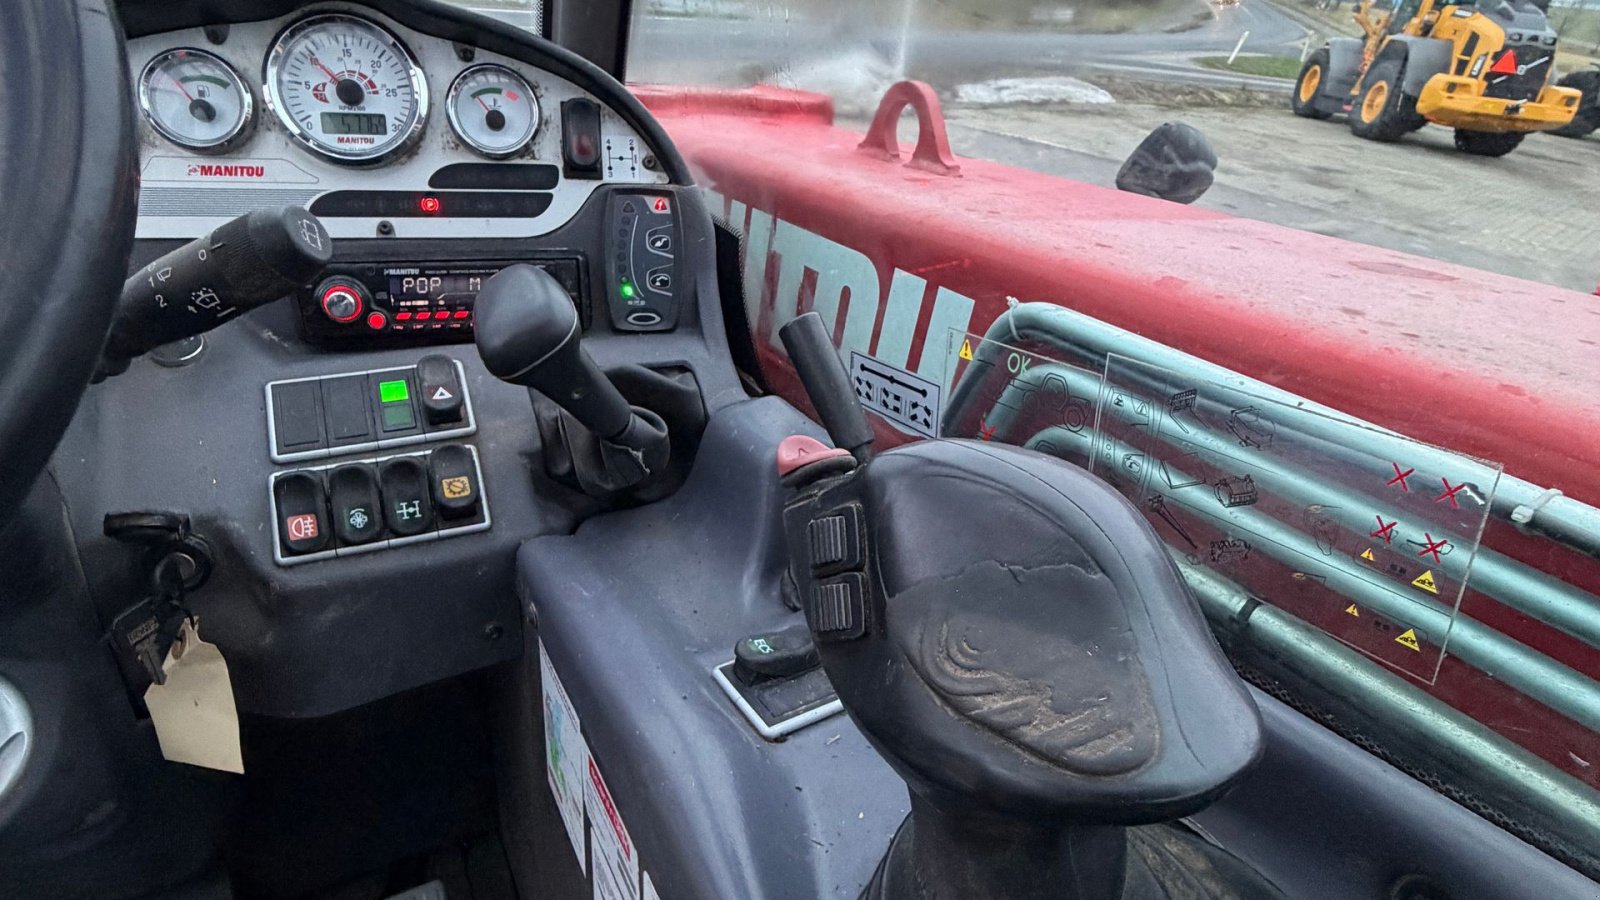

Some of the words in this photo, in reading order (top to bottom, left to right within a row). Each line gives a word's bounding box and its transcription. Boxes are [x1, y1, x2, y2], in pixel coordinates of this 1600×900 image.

[342, 49, 352, 57] 15
[370, 60, 382, 68] 20
[304, 81, 311, 89] 5
[385, 88, 397, 97] 25
[306, 121, 313, 130] 0
[391, 124, 402, 132] 30
[200, 165, 264, 177] MANITOU
[198, 249, 207, 261] 0
[148, 276, 155, 288] 1
[403, 277, 442, 294] POP
[155, 294, 168, 309] 2
[1007, 352, 1031, 376] OK
